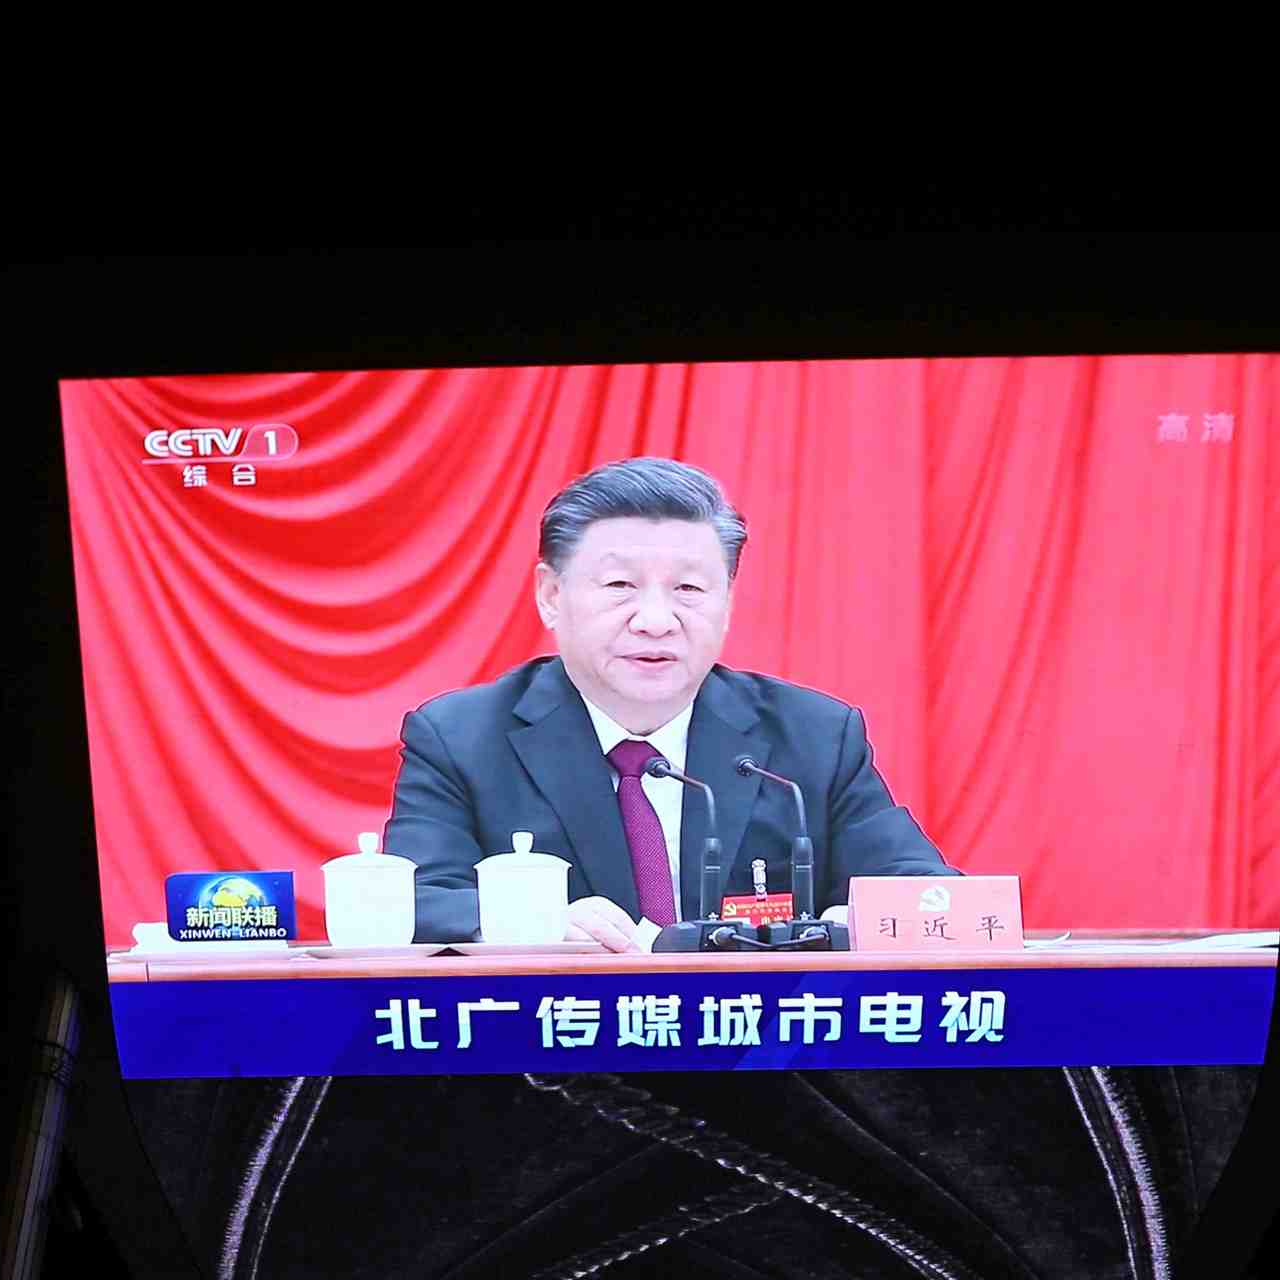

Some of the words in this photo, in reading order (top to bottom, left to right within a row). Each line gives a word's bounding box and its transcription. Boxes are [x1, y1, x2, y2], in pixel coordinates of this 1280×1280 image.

[1157, 412, 1234, 443] 高清
[144, 428, 242, 457] CCTV
[264, 431, 277, 455] 1
[183, 464, 256, 487] 综合
[186, 906, 278, 928] 新闻联播
[877, 914, 1007, 942] 习近平
[375, 991, 1005, 1050] 北广传媒城市电视
